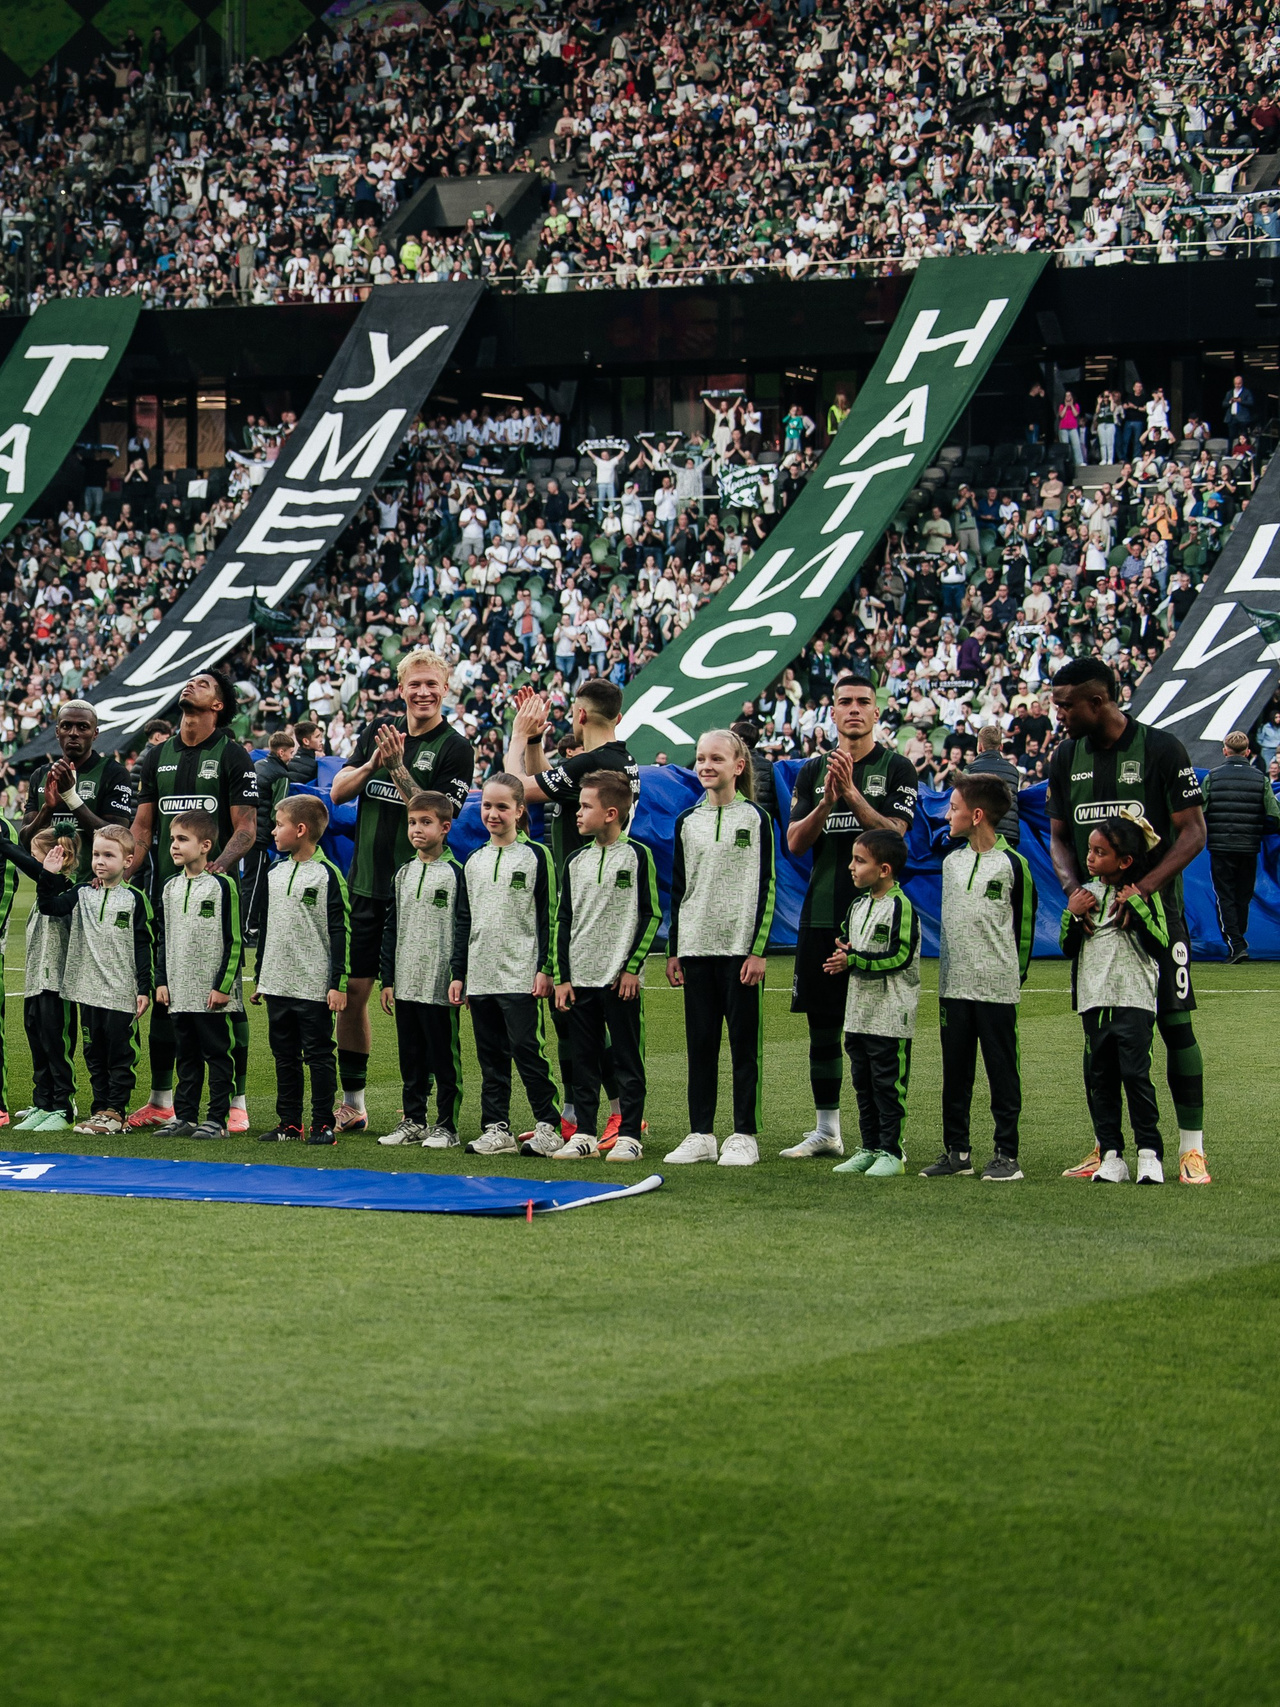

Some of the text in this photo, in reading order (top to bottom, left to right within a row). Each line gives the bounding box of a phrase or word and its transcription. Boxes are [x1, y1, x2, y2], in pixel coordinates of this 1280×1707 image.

[611, 298, 1009, 746] НАТИСК
[94, 325, 450, 735] УМЕНИЯ
[157, 764, 178, 772] OZON
[1071, 771, 1093, 782] OZON
[162, 799, 203, 811] WINLINE
[825, 816, 860, 830] INLIN
[1176, 949, 1186, 958] hh
[1175, 966, 1189, 1000] 9
